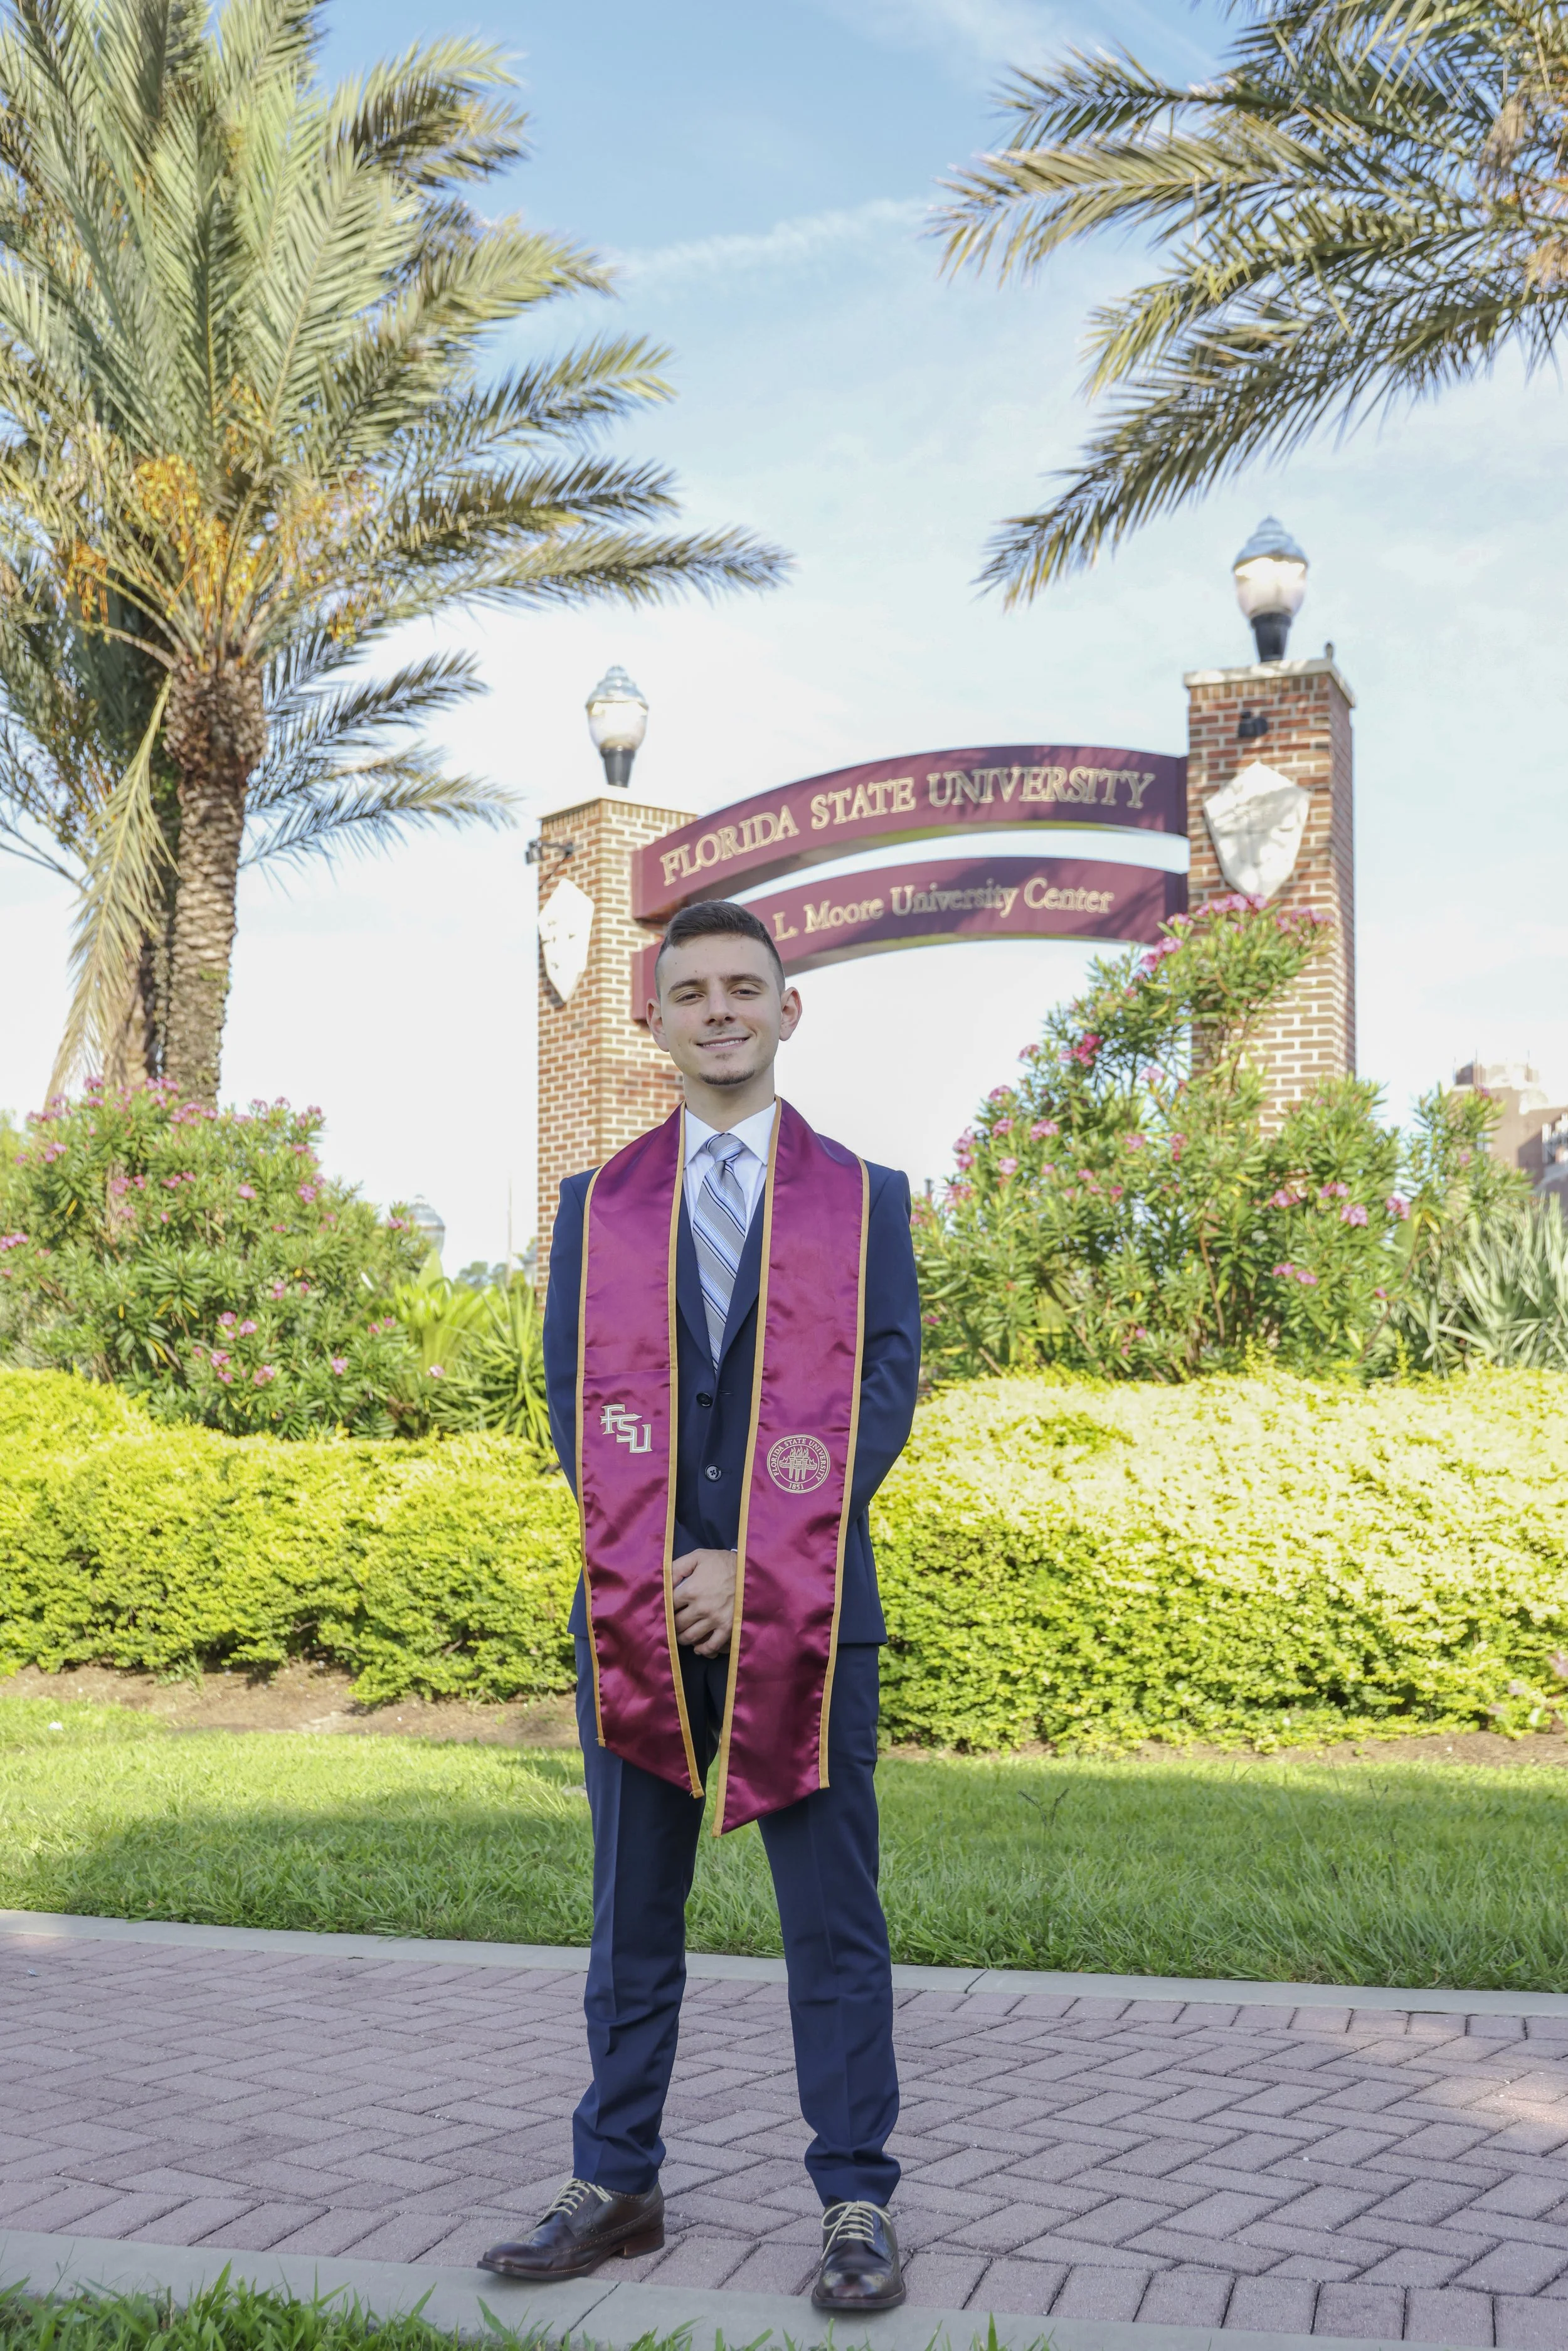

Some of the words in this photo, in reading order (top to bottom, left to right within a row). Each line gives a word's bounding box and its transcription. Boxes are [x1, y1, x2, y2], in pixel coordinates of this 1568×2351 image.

[660, 805, 799, 886] FLORIDA
[810, 777, 916, 830] STATE
[926, 765, 1155, 809] UNIVERSITY
[803, 898, 884, 934] Moore
[891, 878, 1020, 918] University
[1024, 878, 1115, 914] Center
[600, 1404, 652, 1453] FSU
[771, 1446, 784, 1477] FLORIDA
[784, 1438, 807, 1447] STATE
[808, 1440, 827, 1482] UNIVERSITY
